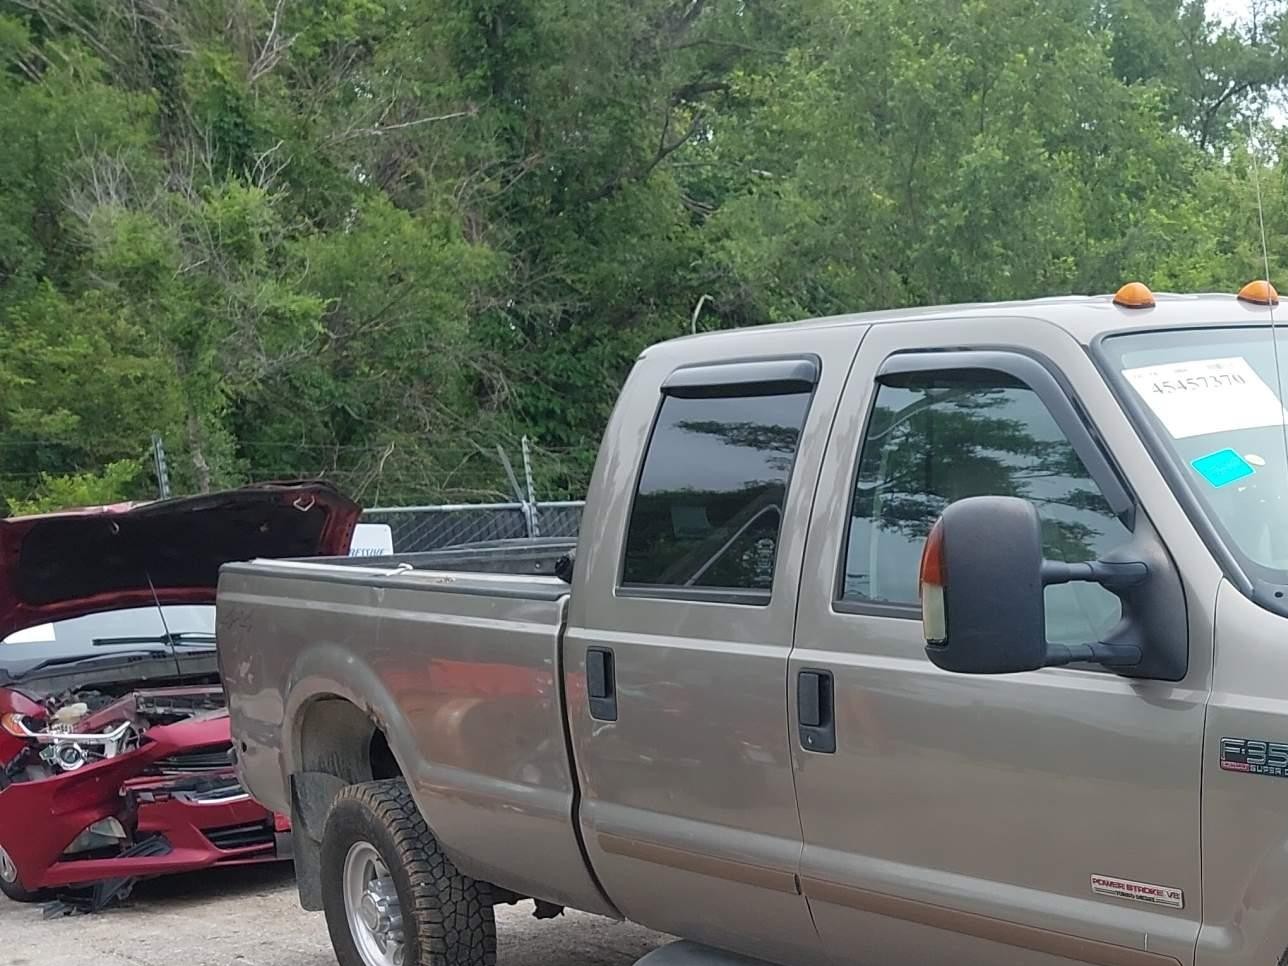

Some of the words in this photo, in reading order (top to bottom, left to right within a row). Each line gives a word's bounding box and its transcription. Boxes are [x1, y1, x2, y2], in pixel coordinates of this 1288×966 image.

[1152, 374, 1247, 395] 45457370
[1250, 764, 1282, 776] SUPER
[1092, 877, 1126, 891] POWER
[1126, 883, 1164, 897] STROKE
[1166, 890, 1181, 900] V8
